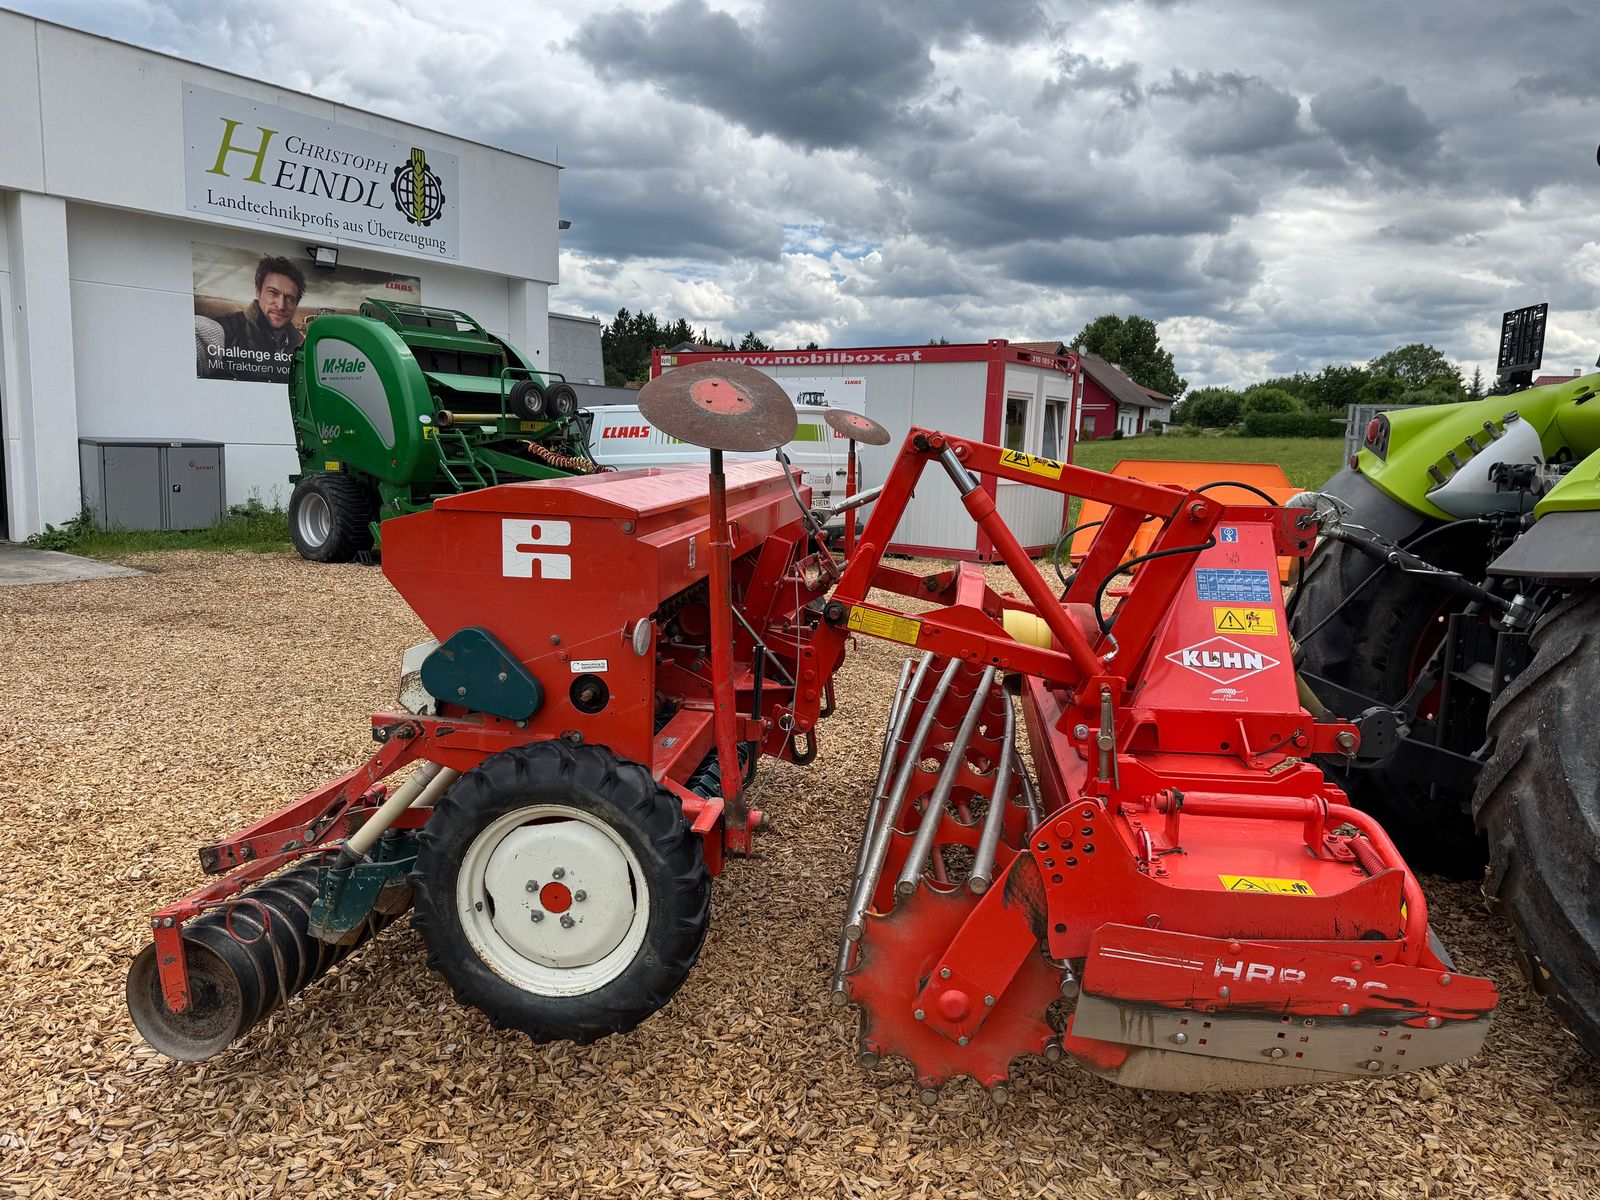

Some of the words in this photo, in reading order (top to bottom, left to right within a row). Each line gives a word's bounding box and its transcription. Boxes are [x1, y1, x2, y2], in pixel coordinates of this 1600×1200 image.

[205, 117, 386, 210] HEINDL
[207, 189, 339, 229] Landtechnikprofis
[342, 220, 364, 233] aus
[367, 219, 447, 253] Überzeugung
[385, 281, 413, 292] CLAAS
[207, 344, 271, 362] Challenge
[208, 359, 224, 370] Mit
[226, 360, 274, 373] Traktoren
[322, 358, 366, 373] McHale
[317, 421, 341, 439] V660
[602, 426, 650, 438] CLAAS
[1182, 650, 1264, 670] KUHN
